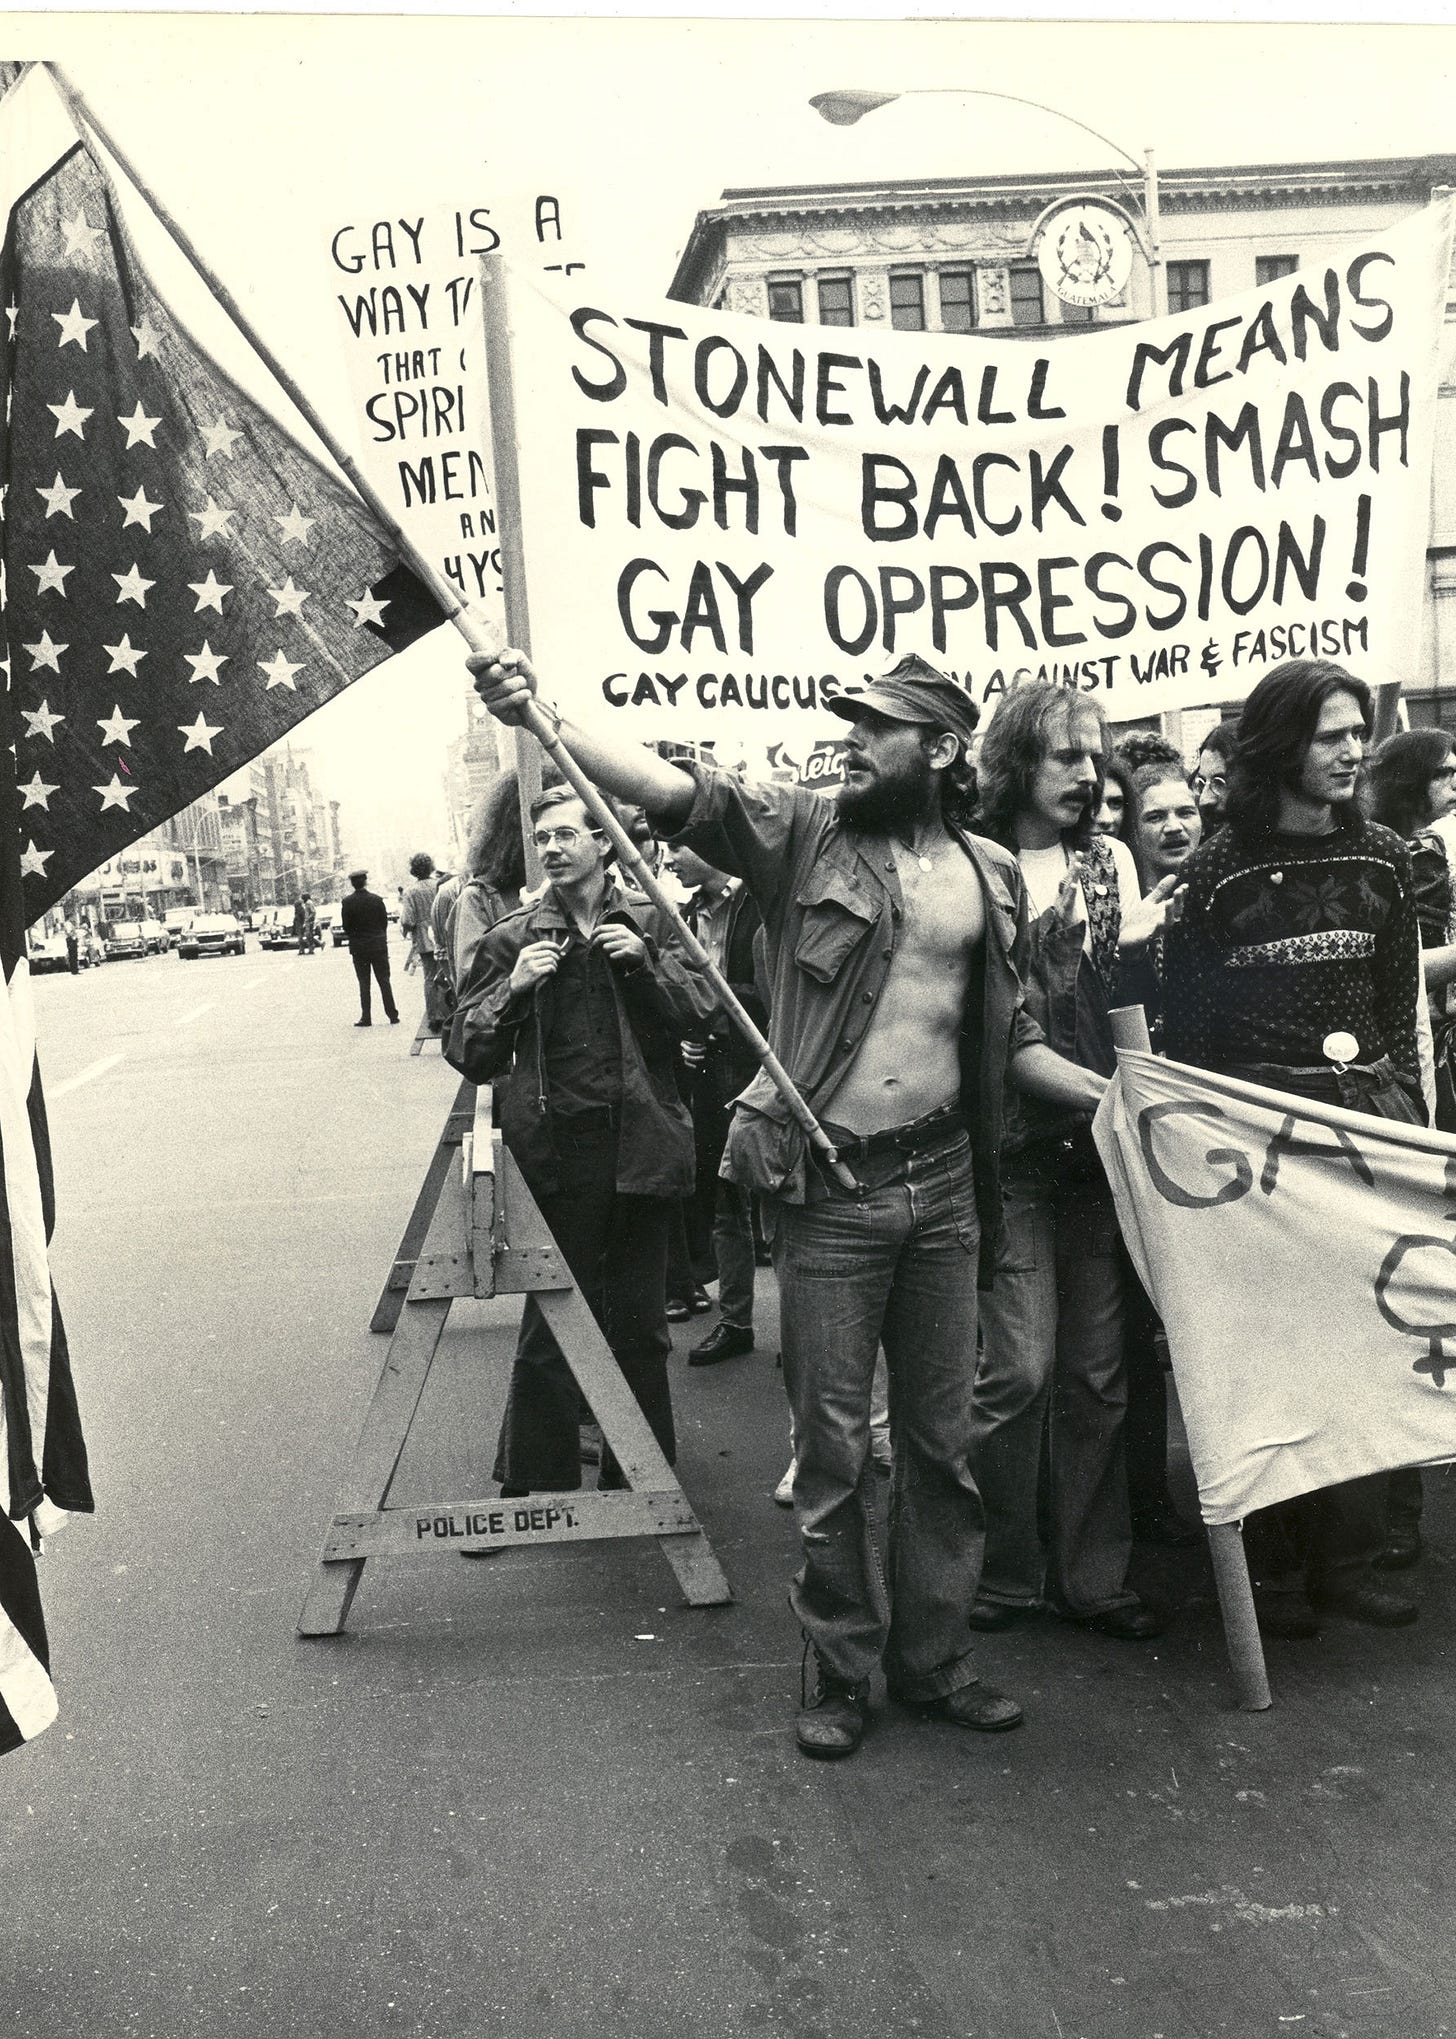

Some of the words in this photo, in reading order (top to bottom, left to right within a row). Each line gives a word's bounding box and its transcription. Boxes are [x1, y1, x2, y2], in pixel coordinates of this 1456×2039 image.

[332, 217, 425, 273] GAY
[456, 208, 501, 257] IS
[535, 195, 562, 243] A
[337, 284, 430, 338] WAY
[569, 306, 1067, 427] STONEWALL
[1125, 251, 1396, 412] MEANS
[377, 347, 442, 385] THAT
[575, 428, 811, 538] FIGHT
[1148, 370, 1411, 509] SMASH
[616, 557, 775, 657] GAY
[823, 493, 1372, 657] OPPRESSION!
[601, 672, 688, 708] GAY
[1130, 644, 1191, 685] WAR
[1200, 637, 1224, 678] &
[1232, 615, 1369, 668] FASCISM
[416, 1512, 505, 1539] POLICE
[514, 1505, 580, 1532] DEPT.
